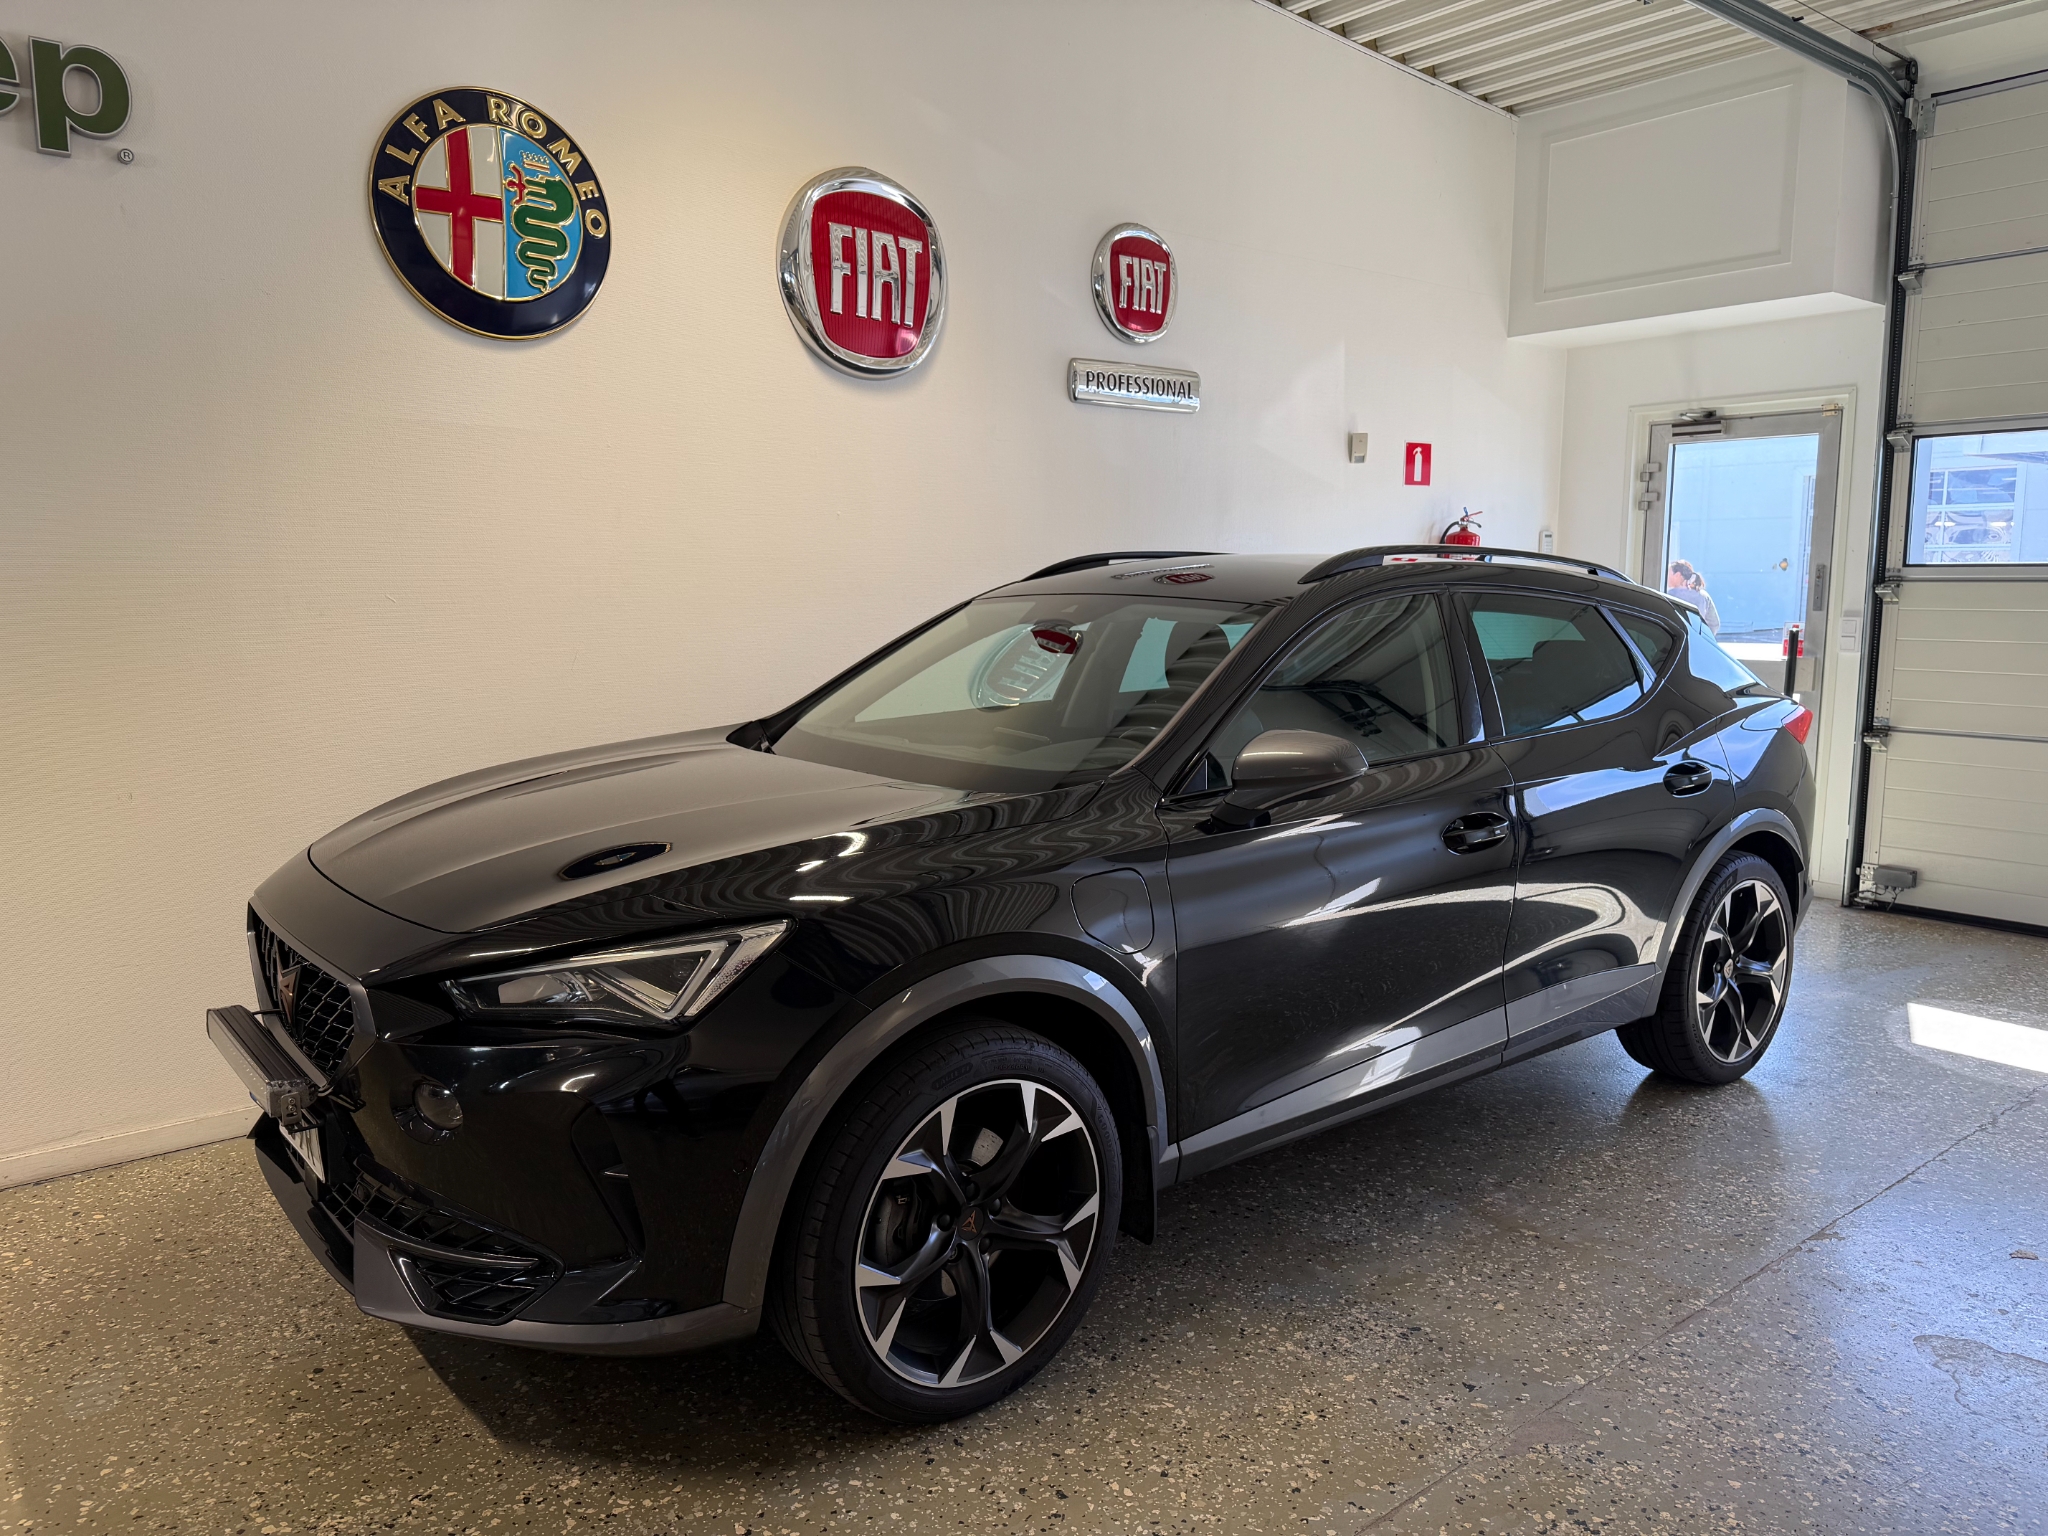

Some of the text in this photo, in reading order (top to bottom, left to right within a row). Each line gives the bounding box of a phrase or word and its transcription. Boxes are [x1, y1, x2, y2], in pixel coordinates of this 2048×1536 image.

[0, 35, 132, 158] p
[378, 95, 607, 239] ALFA ROMEO
[828, 221, 923, 328] FIAT
[1119, 255, 1168, 314] FIAT
[1085, 370, 1195, 400] PROFESSIONAL
